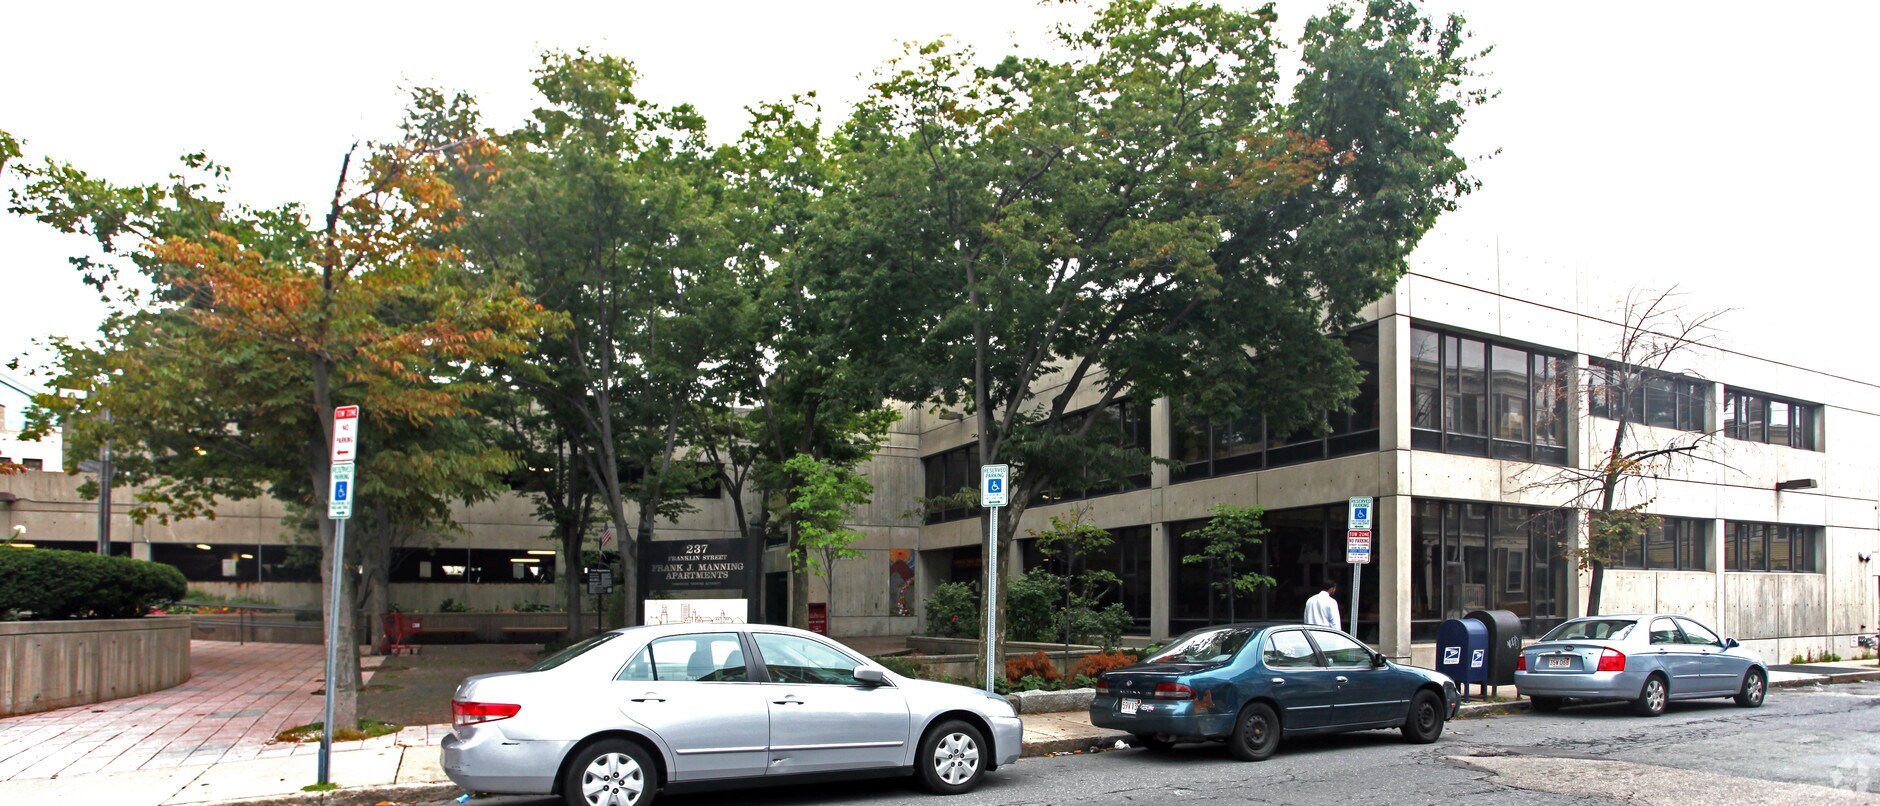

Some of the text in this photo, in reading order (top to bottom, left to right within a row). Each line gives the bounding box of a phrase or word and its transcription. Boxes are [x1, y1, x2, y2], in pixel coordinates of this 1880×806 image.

[336, 408, 357, 418] TOW ZONE
[686, 544, 709, 554] 237
[651, 562, 745, 572] FRANK J. MANNING
[665, 571, 729, 580] APARTMENTS
